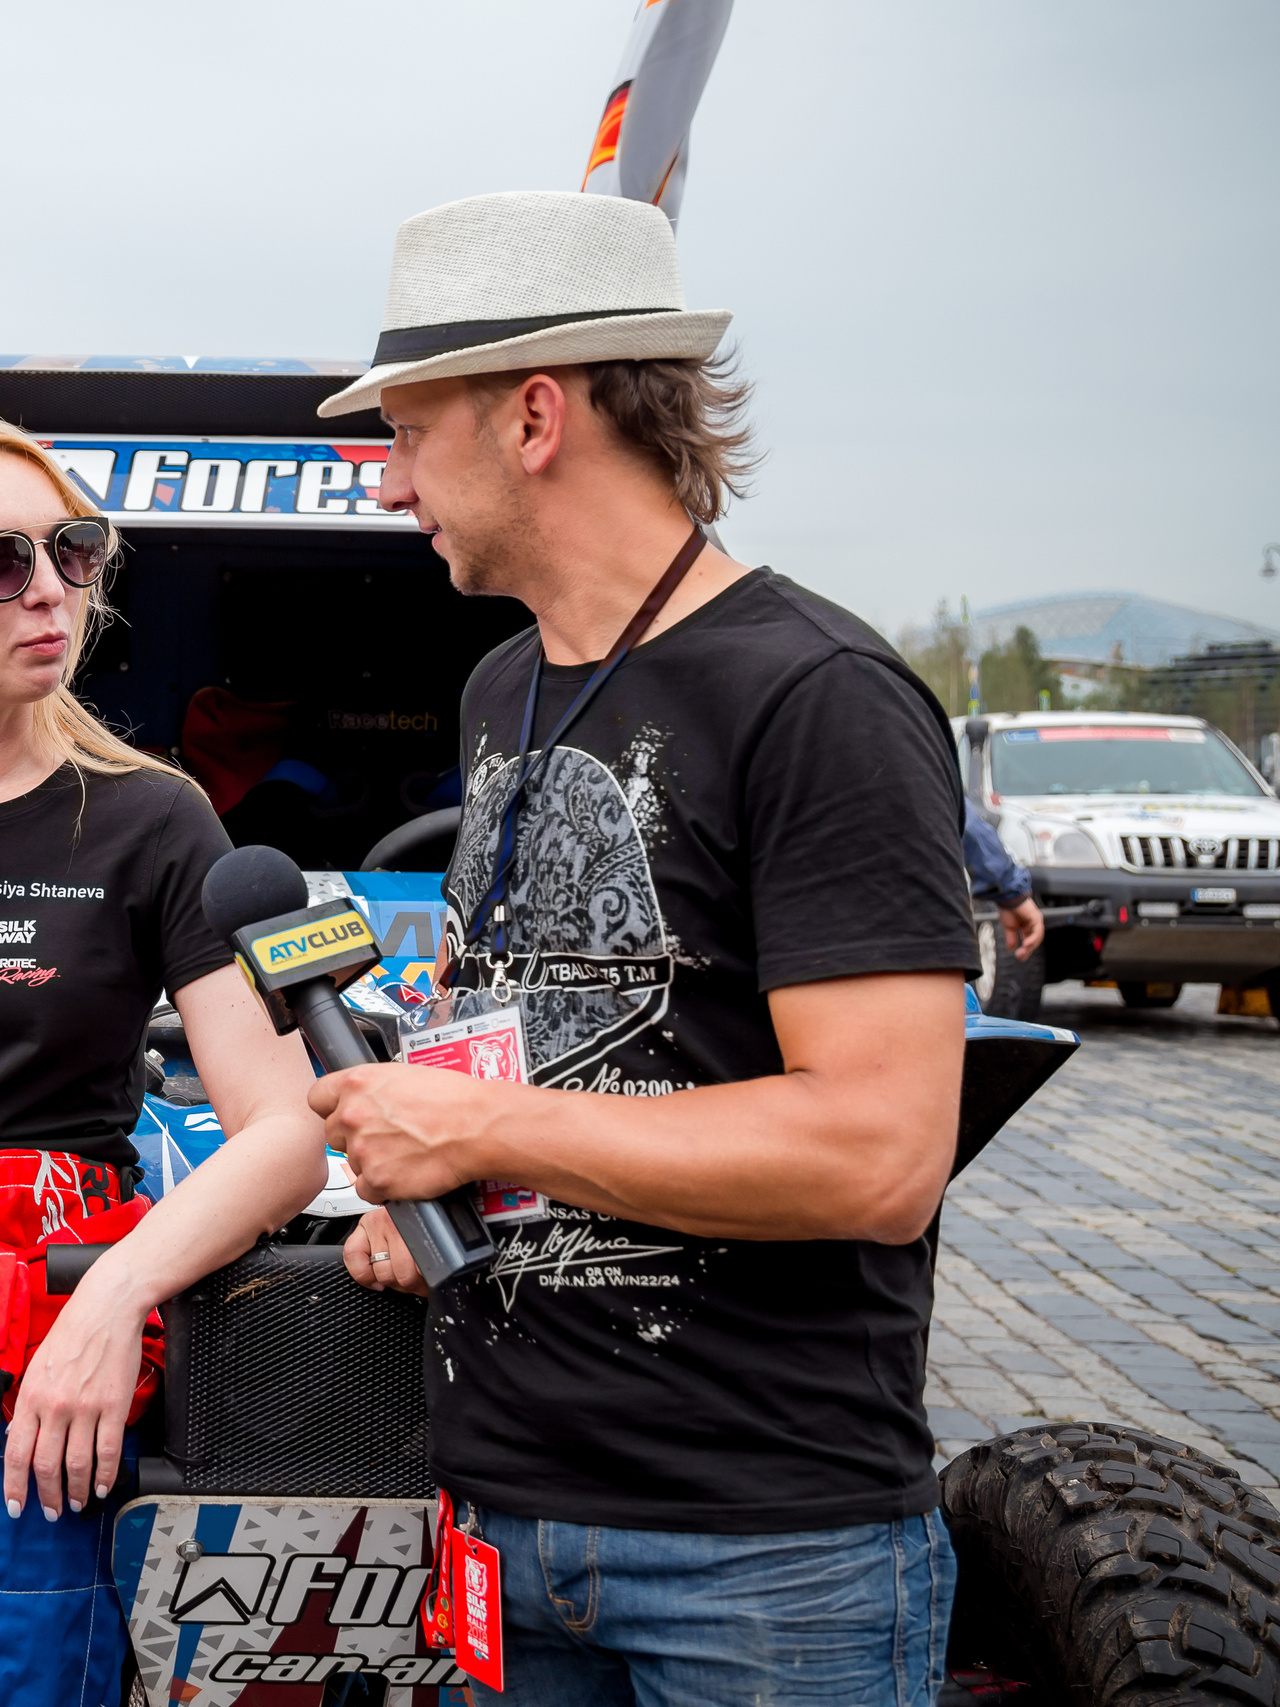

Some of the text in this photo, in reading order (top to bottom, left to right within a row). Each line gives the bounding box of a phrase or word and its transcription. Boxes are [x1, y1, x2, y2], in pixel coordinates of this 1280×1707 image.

[328, 709, 438, 731] Racetech
[29, 882, 105, 900] Shtaneva
[541, 1206, 592, 1221] NSAS
[466, 1591, 487, 1612] SILK
[466, 1603, 487, 1622] WAY
[466, 1614, 488, 1632] RALLY
[467, 1624, 489, 1645] 2018
